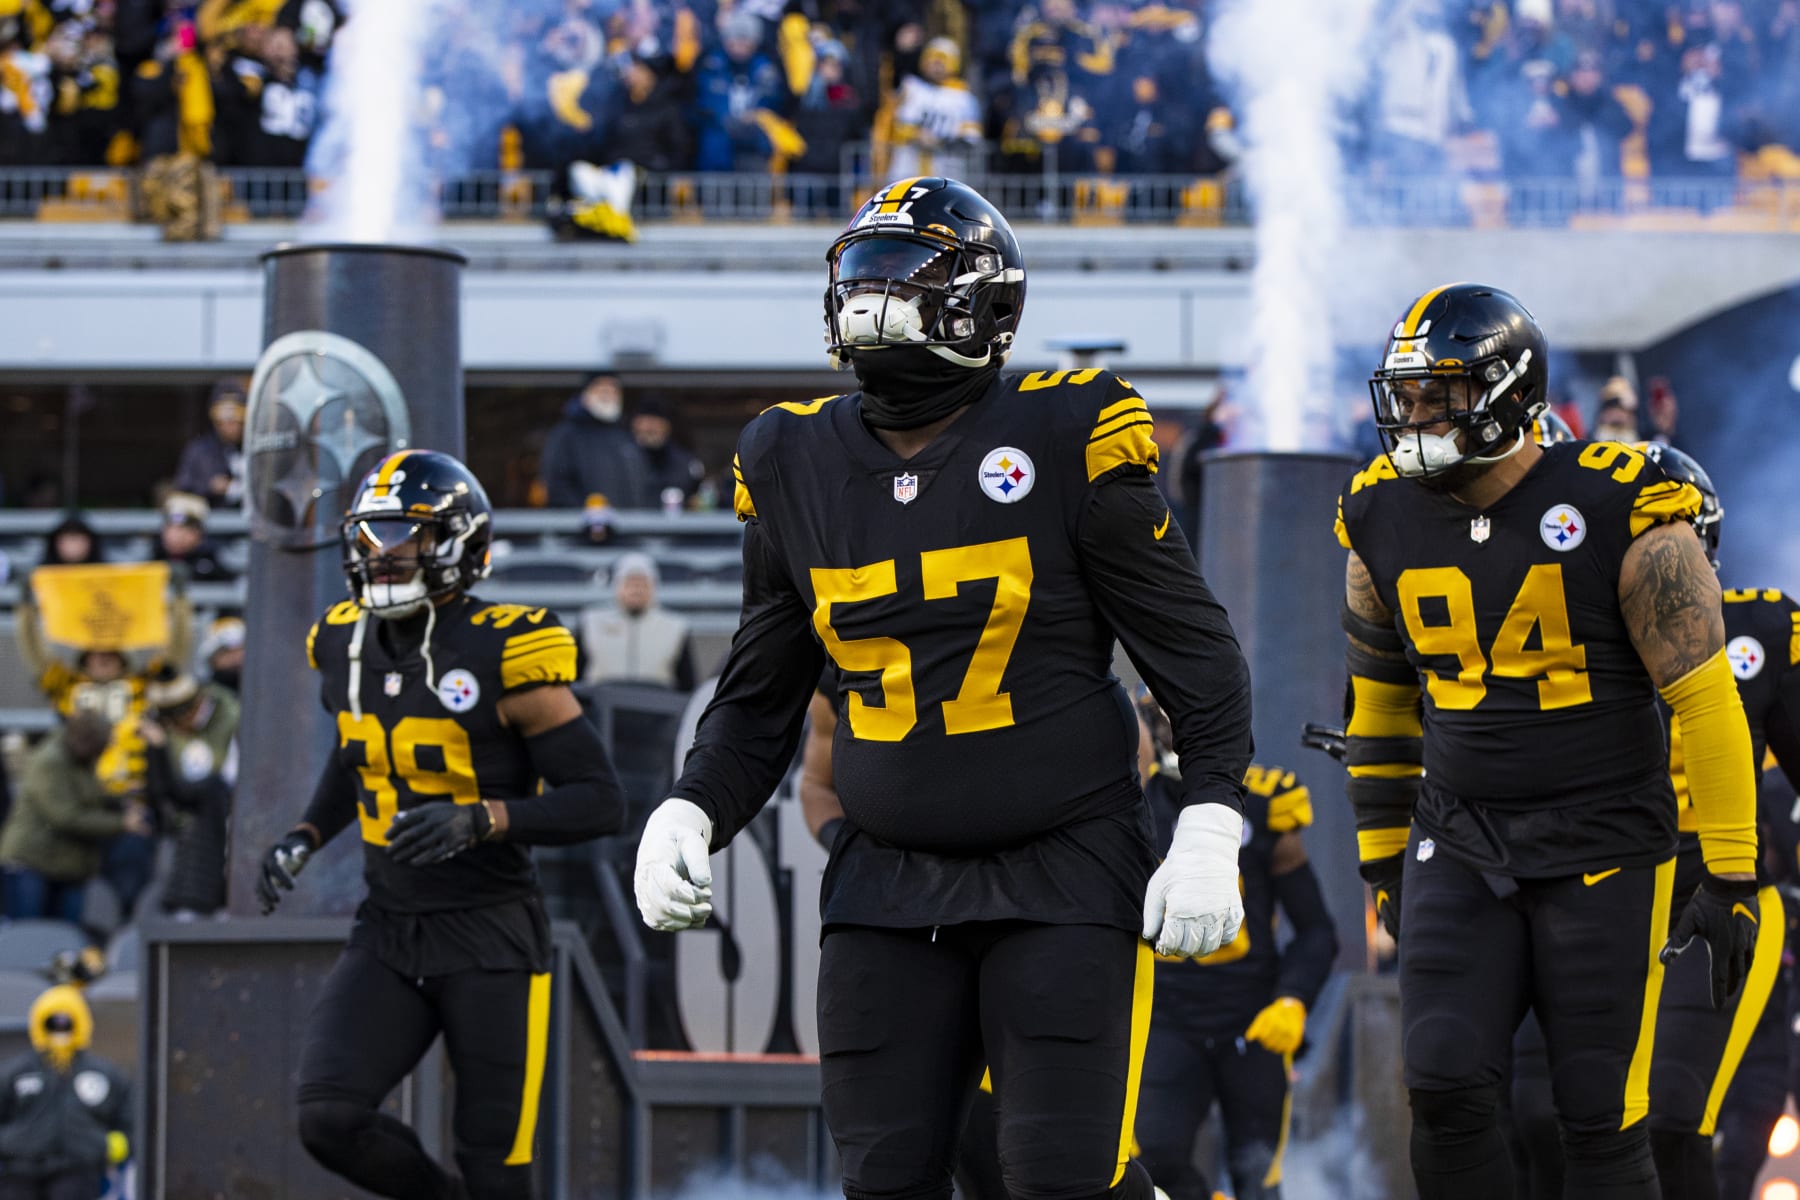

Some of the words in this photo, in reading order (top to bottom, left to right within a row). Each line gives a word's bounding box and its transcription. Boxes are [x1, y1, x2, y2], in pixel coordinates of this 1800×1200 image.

[897, 485, 914, 498] NFL
[983, 471, 1005, 479] Steelers
[1578, 441, 1645, 484] 9
[809, 536, 1034, 742] 57
[1396, 563, 1593, 710] 94
[337, 710, 480, 846] 39
